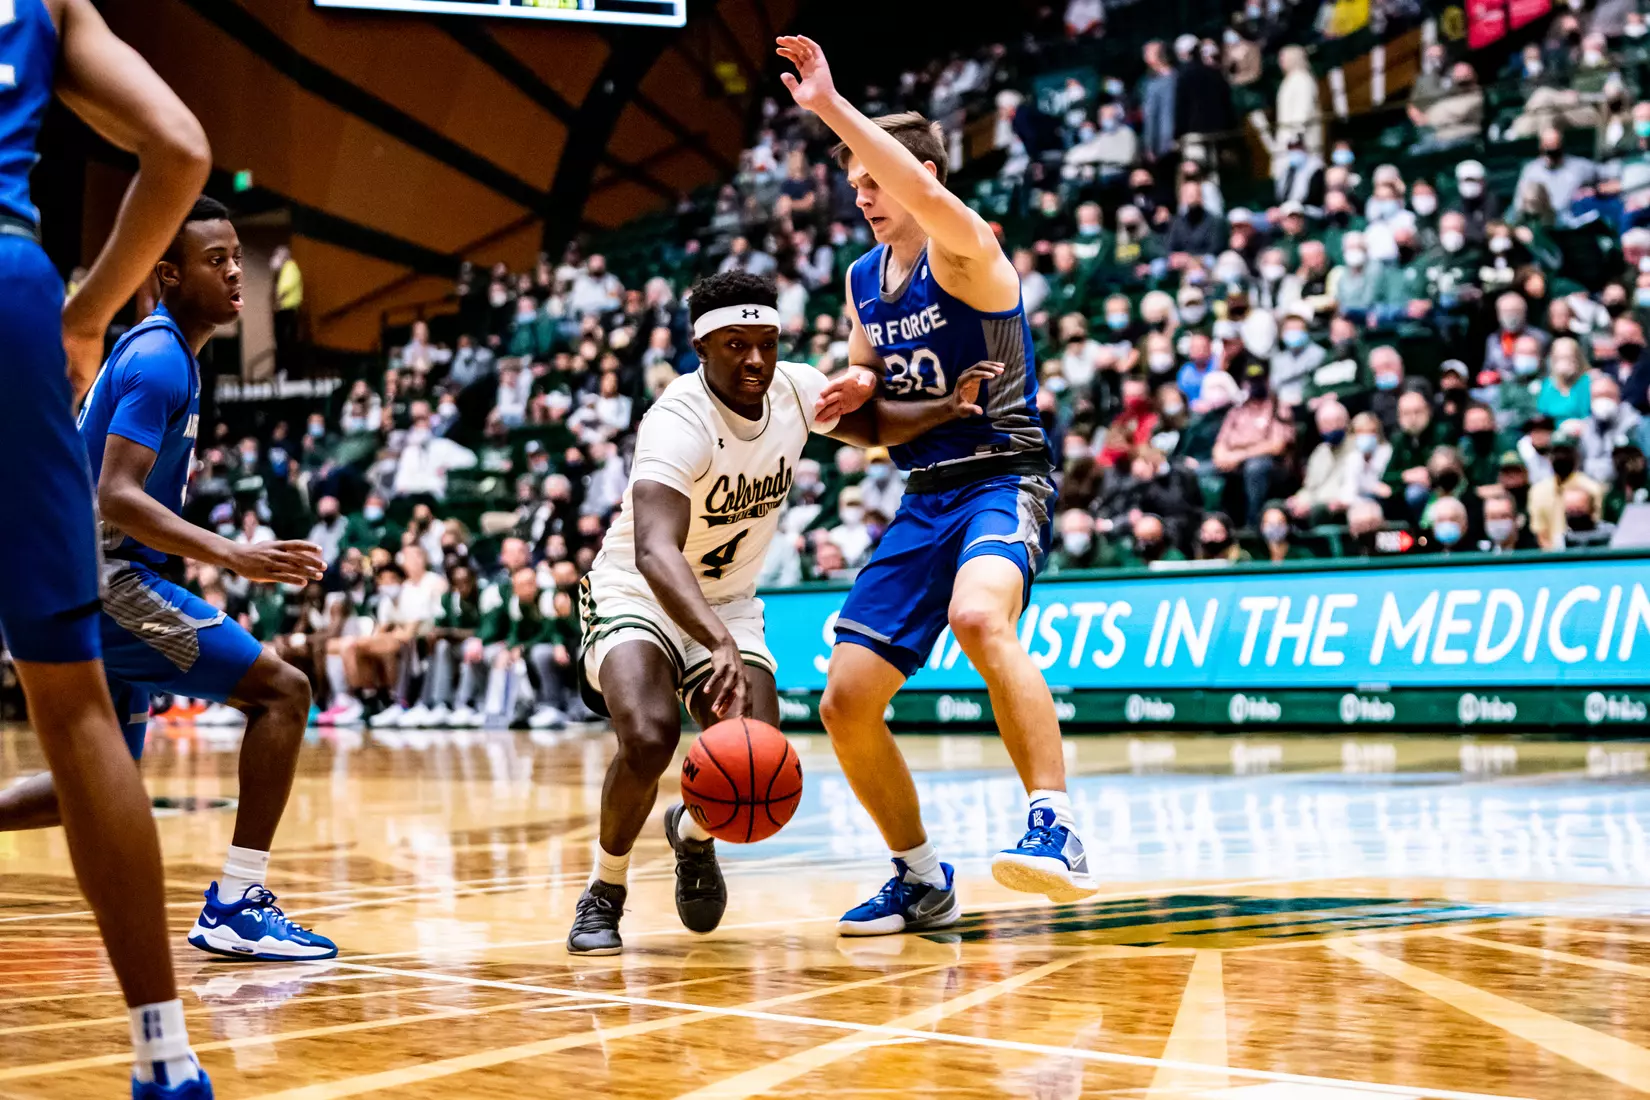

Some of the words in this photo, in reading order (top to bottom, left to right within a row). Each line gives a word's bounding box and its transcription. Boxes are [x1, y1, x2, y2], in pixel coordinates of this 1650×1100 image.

[886, 303, 947, 345] FORCE
[884, 347, 947, 396] 30
[700, 528, 749, 580] 4
[1144, 597, 1219, 667] IN
[1238, 593, 1358, 667] THE
